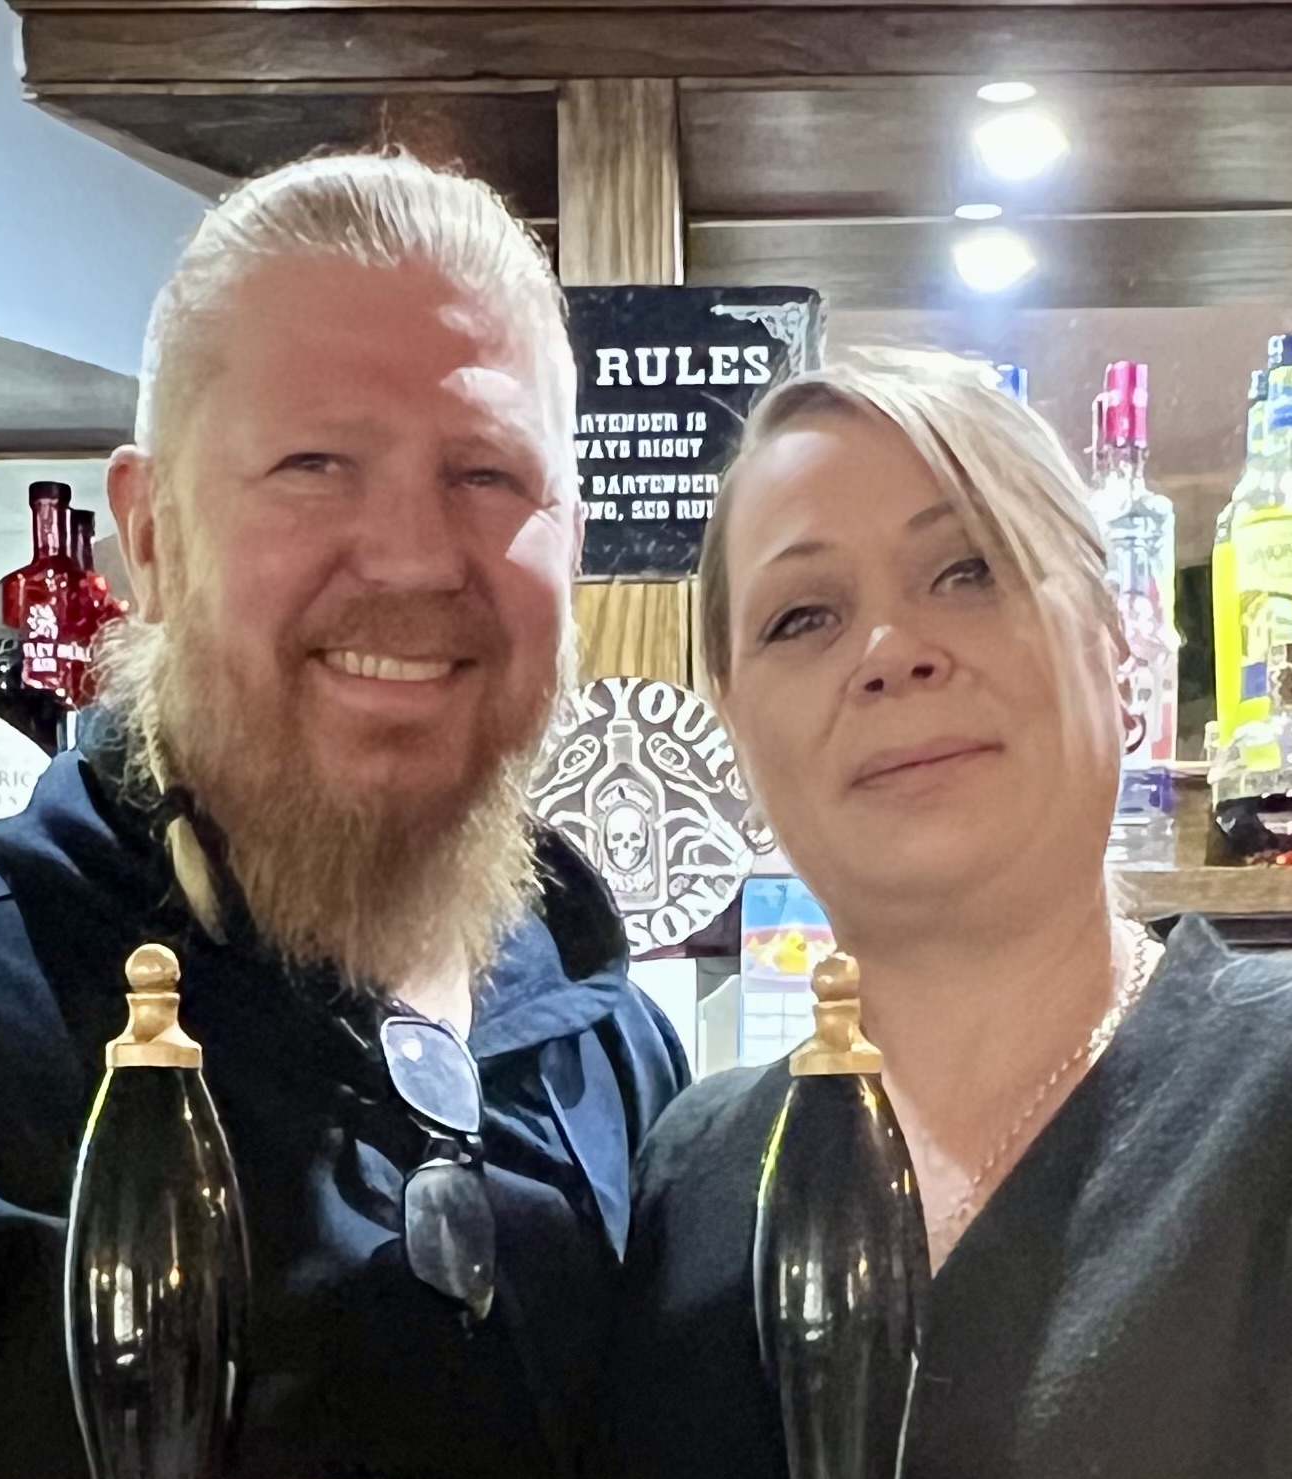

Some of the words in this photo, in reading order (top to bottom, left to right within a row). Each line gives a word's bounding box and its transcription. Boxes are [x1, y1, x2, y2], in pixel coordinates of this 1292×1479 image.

[596, 346, 772, 386] RULES
[686, 412, 707, 431] IS
[603, 677, 735, 778] YOUR
[623, 876, 736, 956] SON
